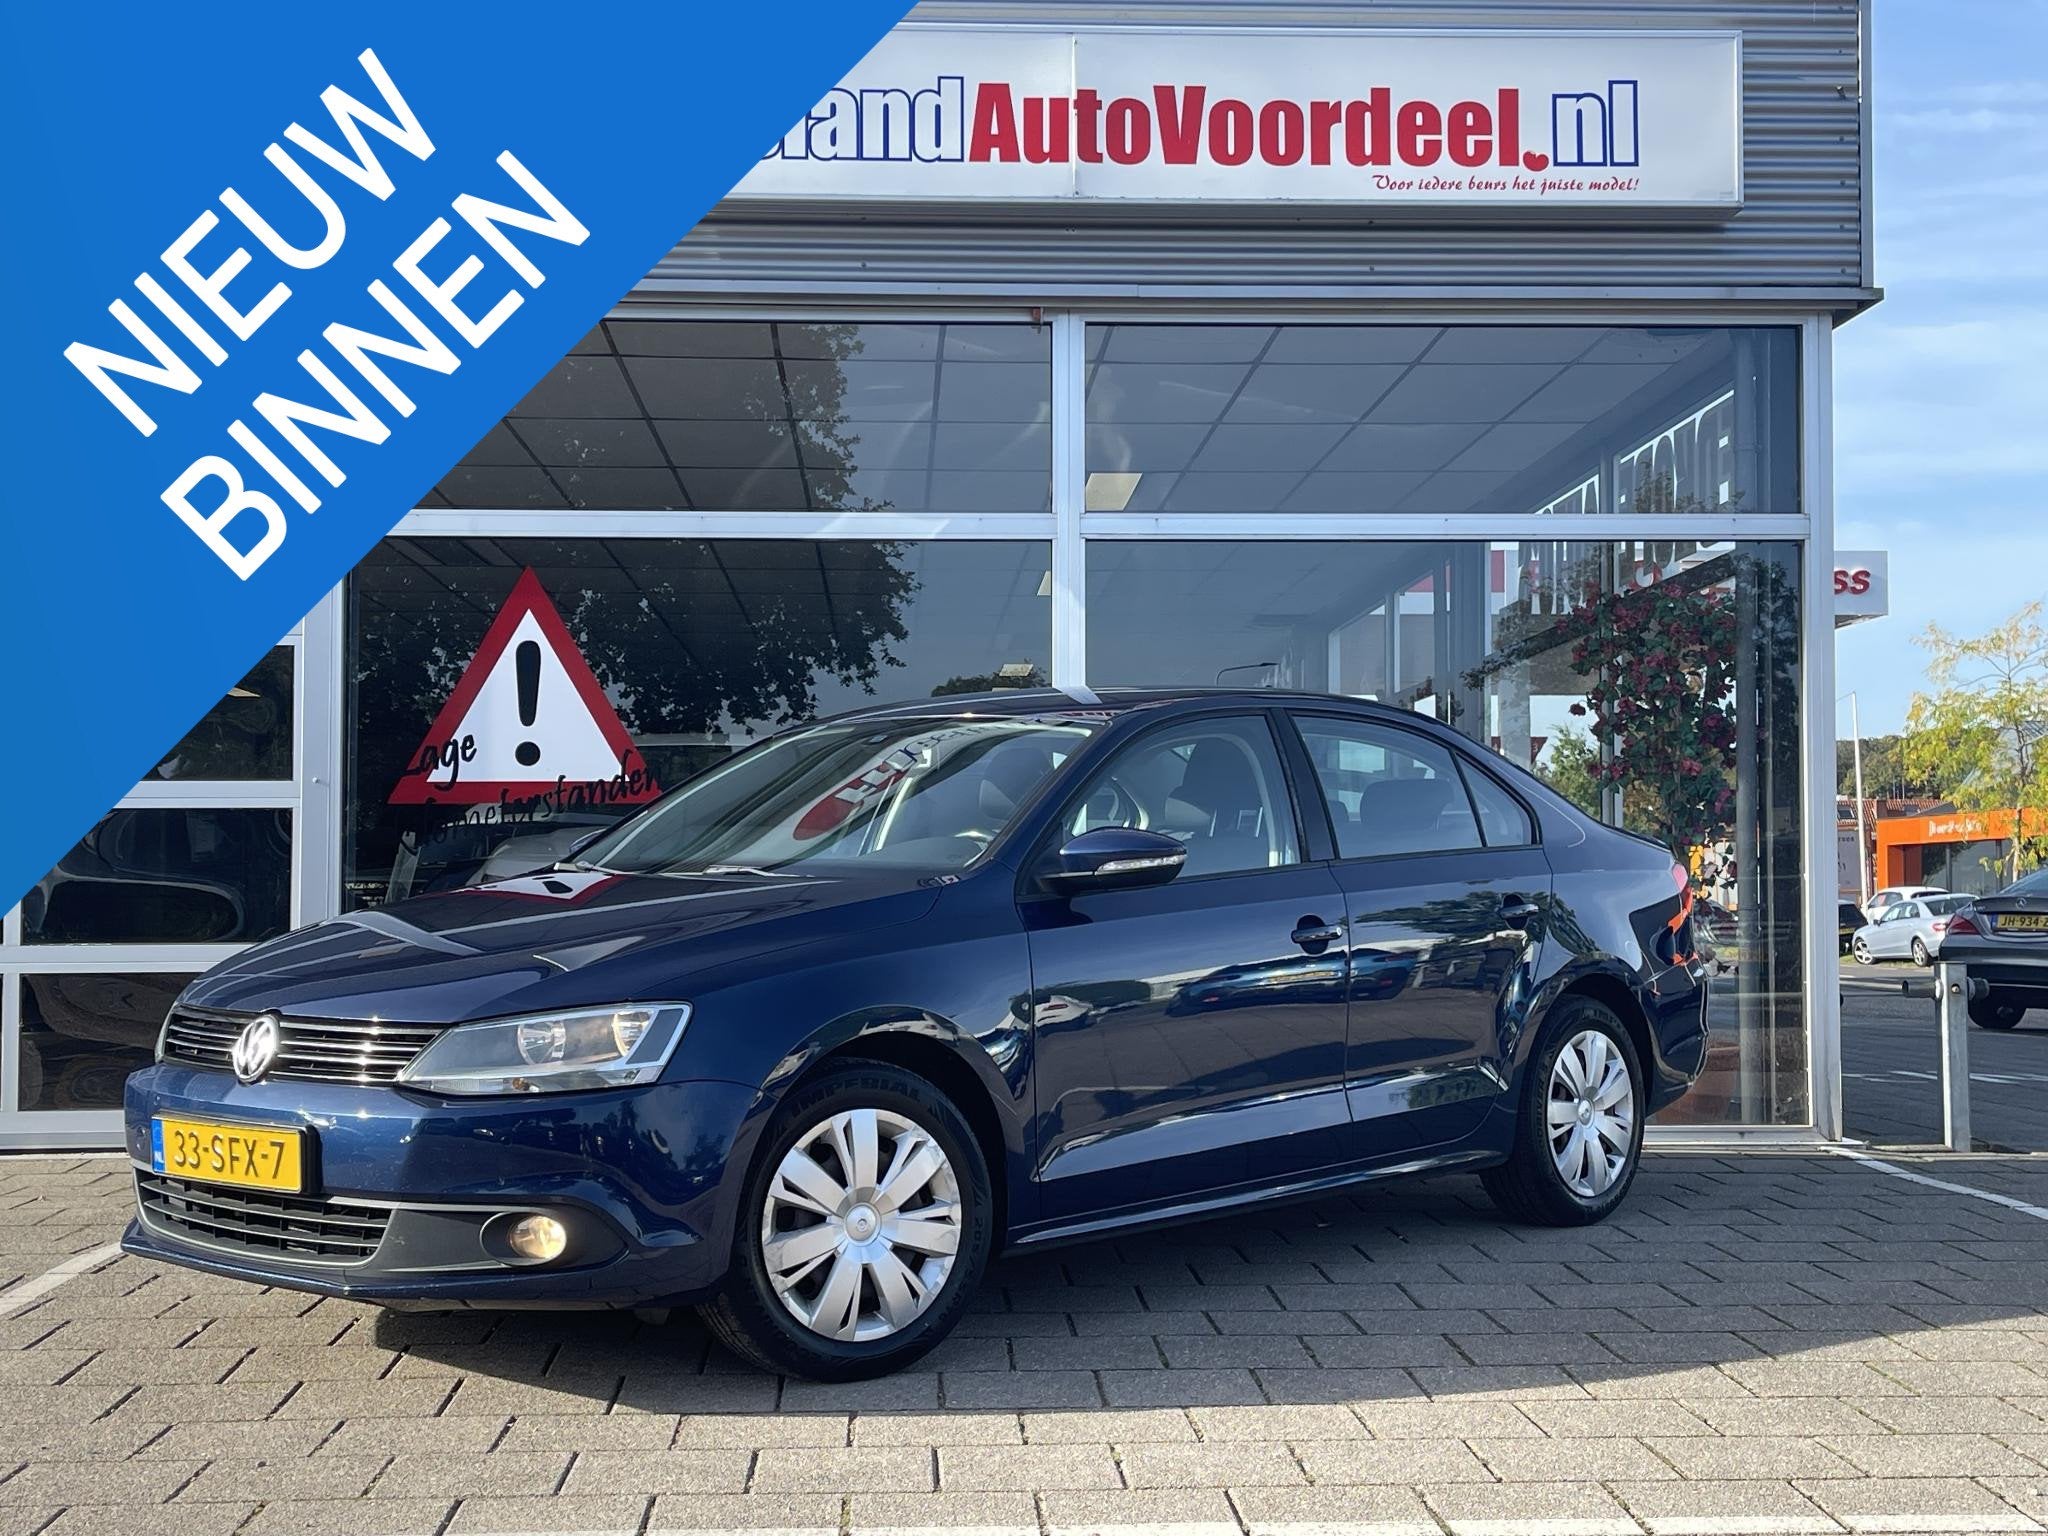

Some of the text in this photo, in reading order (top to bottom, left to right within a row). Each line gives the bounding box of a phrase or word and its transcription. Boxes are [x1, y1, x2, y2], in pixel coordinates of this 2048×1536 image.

[1372, 174, 1639, 195] Voor iedere beurs het juiste model!
[173, 1129, 286, 1180] 33-SFX-7
